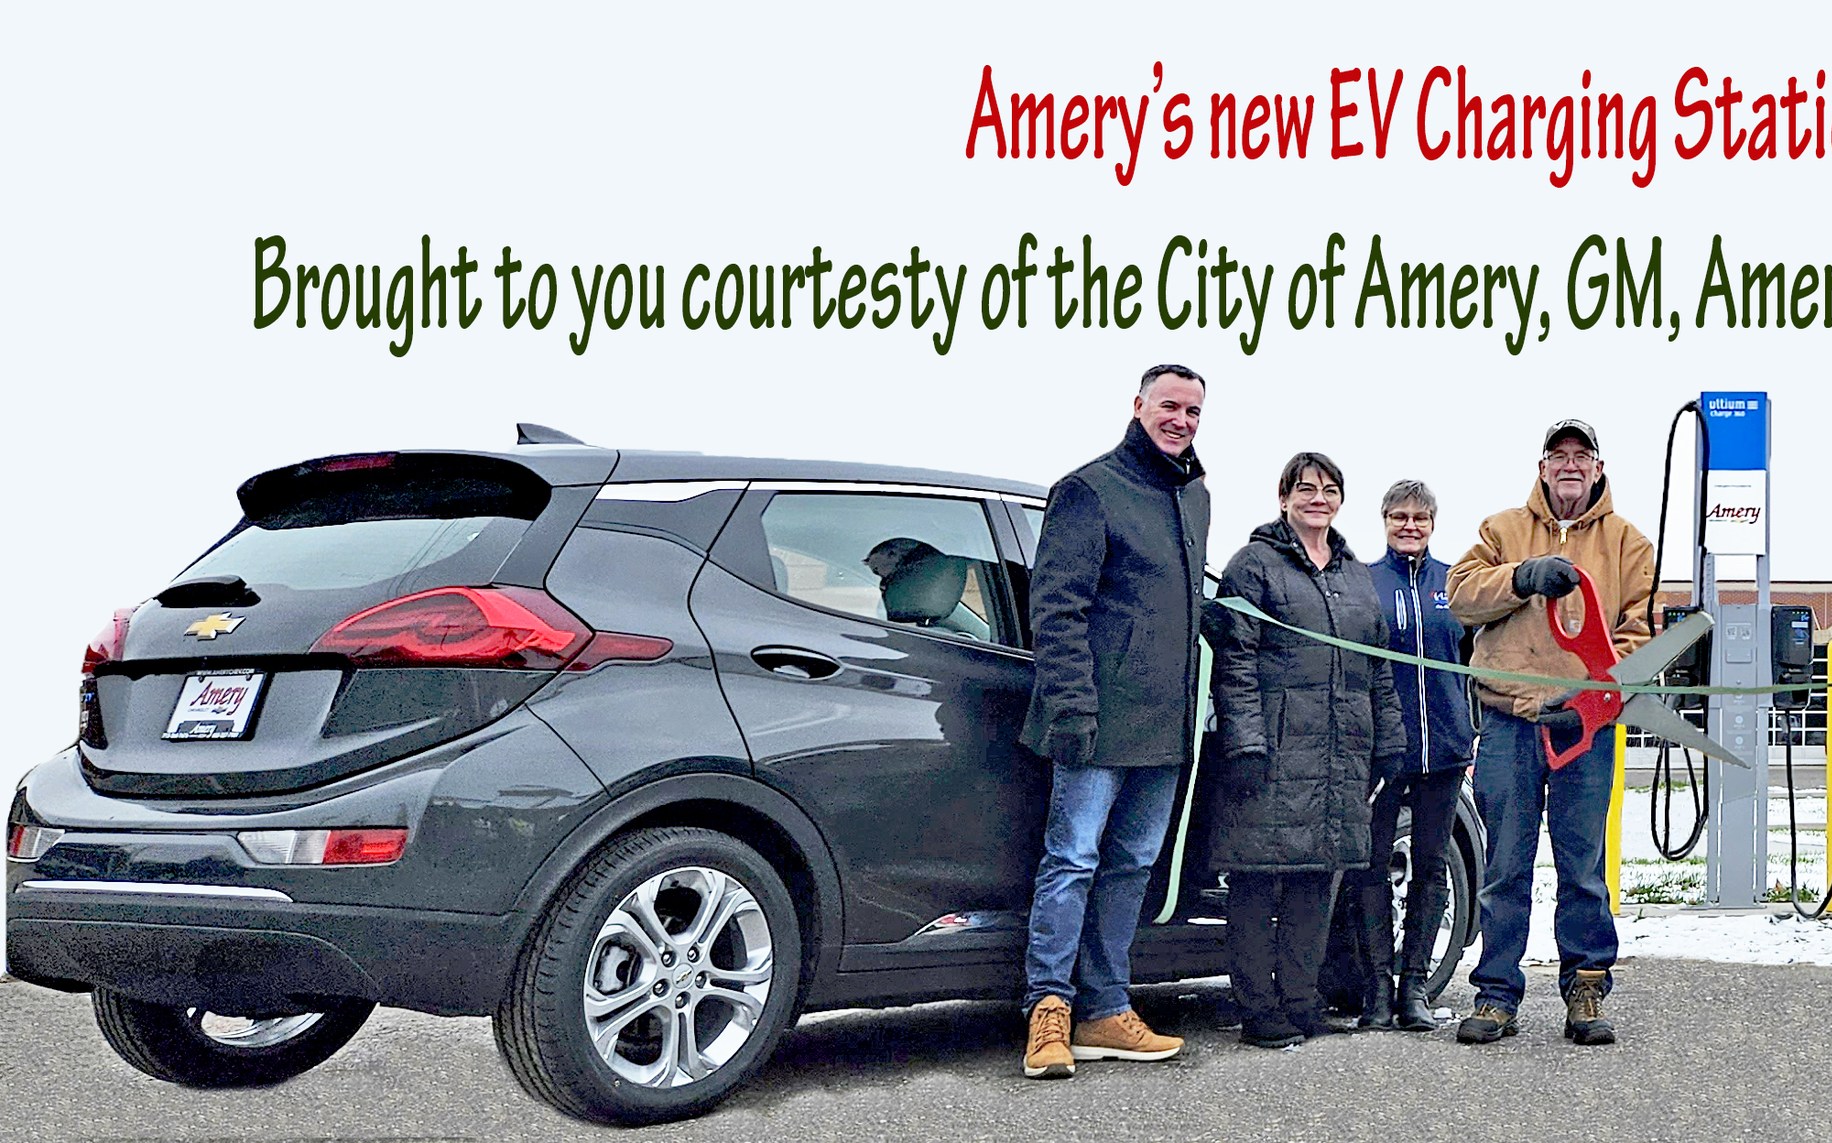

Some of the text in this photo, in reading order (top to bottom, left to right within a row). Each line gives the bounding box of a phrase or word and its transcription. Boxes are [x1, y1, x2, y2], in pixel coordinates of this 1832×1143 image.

[1709, 398, 1745, 409] ultium
[1710, 410, 1732, 418] charge
[1706, 503, 1761, 524] Amery
[190, 681, 249, 716] Amery
